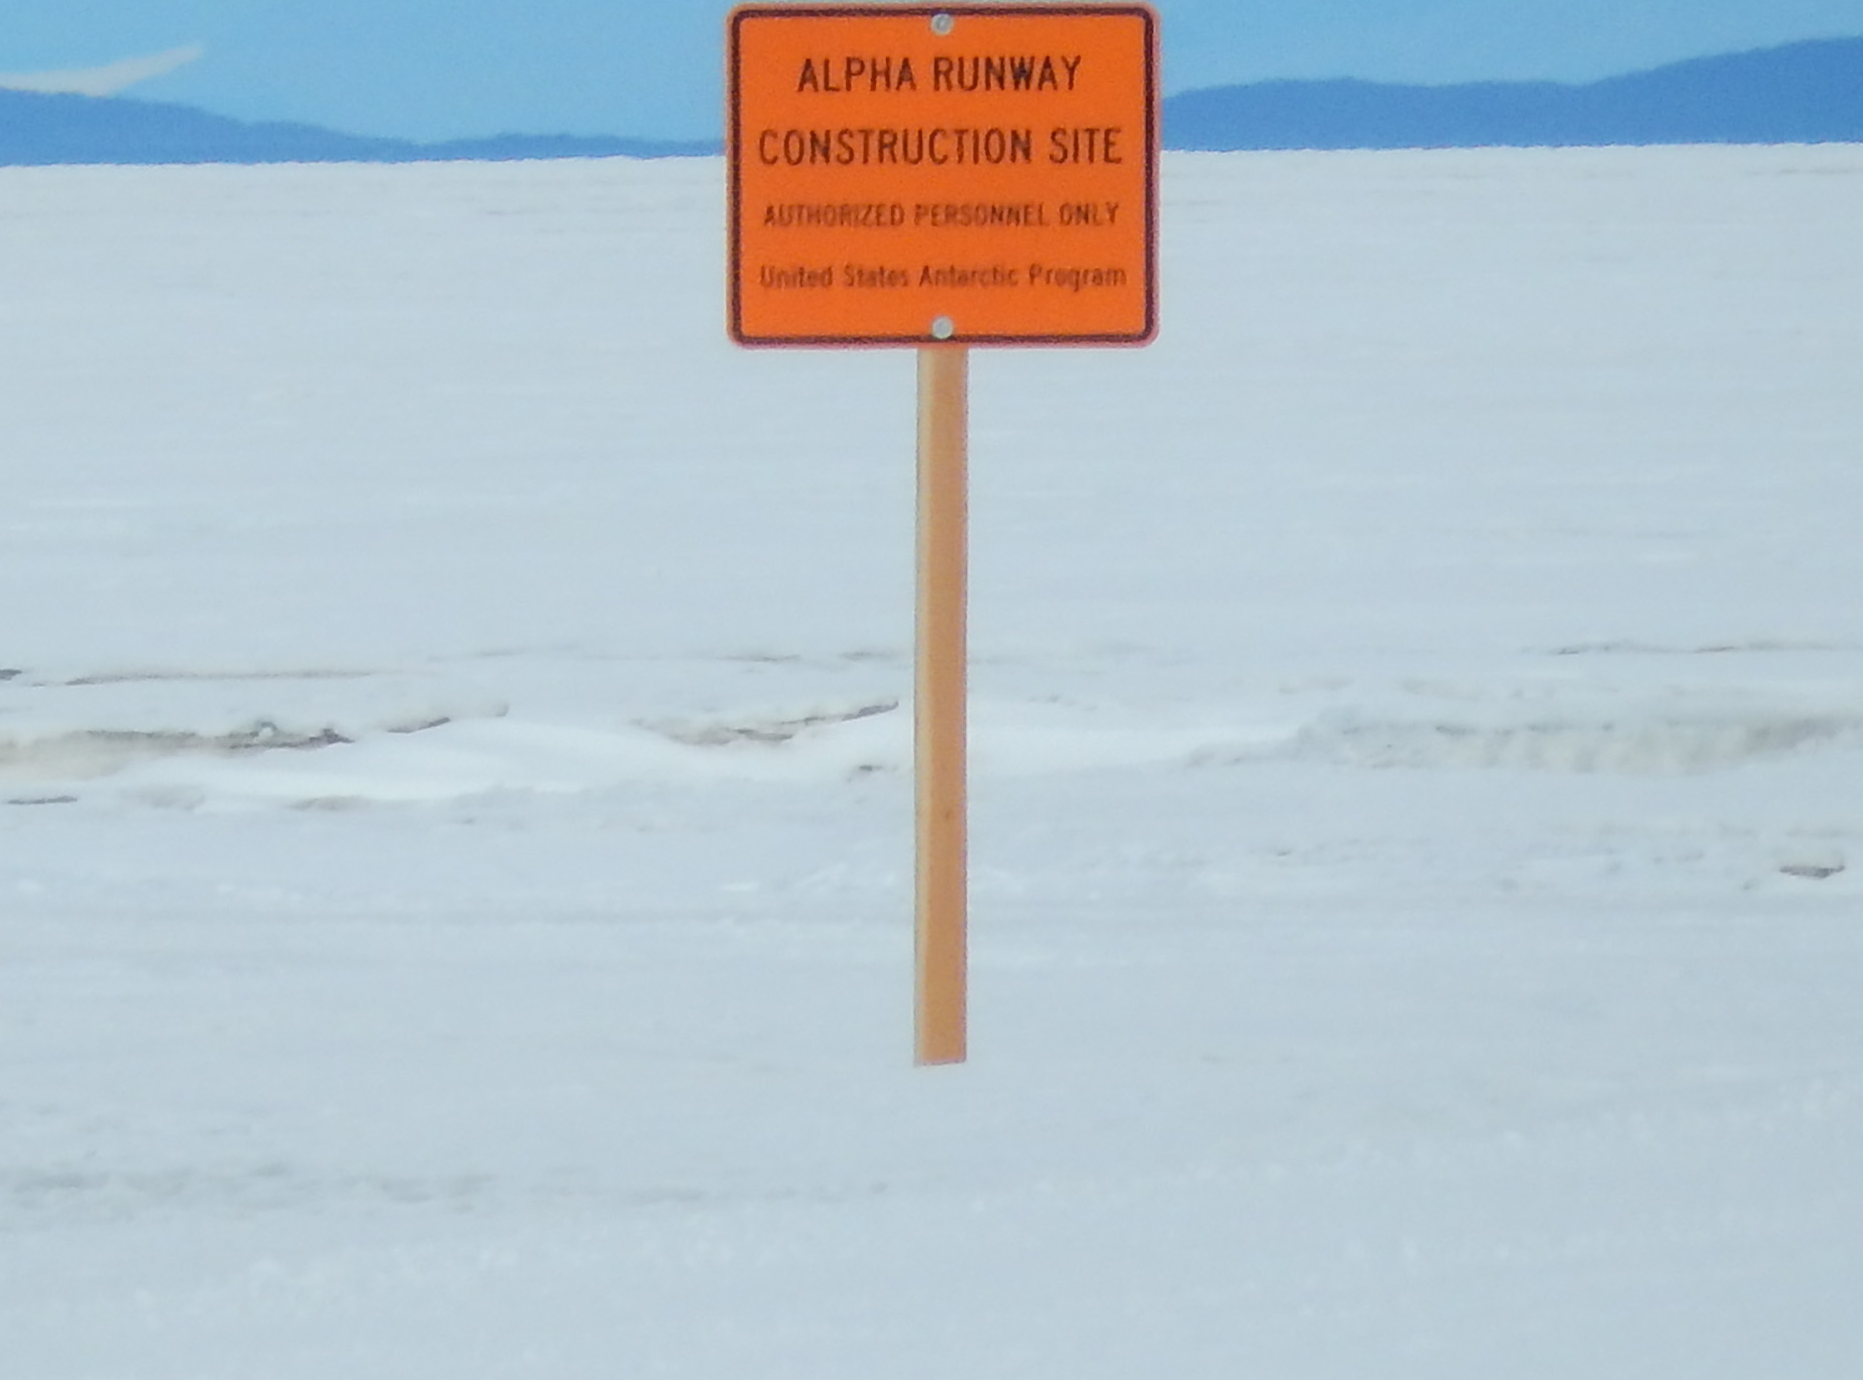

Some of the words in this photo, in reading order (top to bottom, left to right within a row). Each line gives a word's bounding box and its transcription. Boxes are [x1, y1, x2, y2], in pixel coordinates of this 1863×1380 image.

[797, 57, 917, 92] ALPHA
[932, 55, 1082, 92] RUNWAY
[759, 128, 1032, 166] CONSTRUCTION
[1048, 128, 1123, 165] SITE
[764, 203, 905, 227] AUTHORIZED
[914, 203, 1050, 227] PERSONNEL
[1060, 203, 1118, 226] ONLY
[760, 266, 833, 288] United
[843, 266, 909, 288] States
[919, 265, 1019, 288] Antarctic
[1029, 266, 1126, 293] Program
